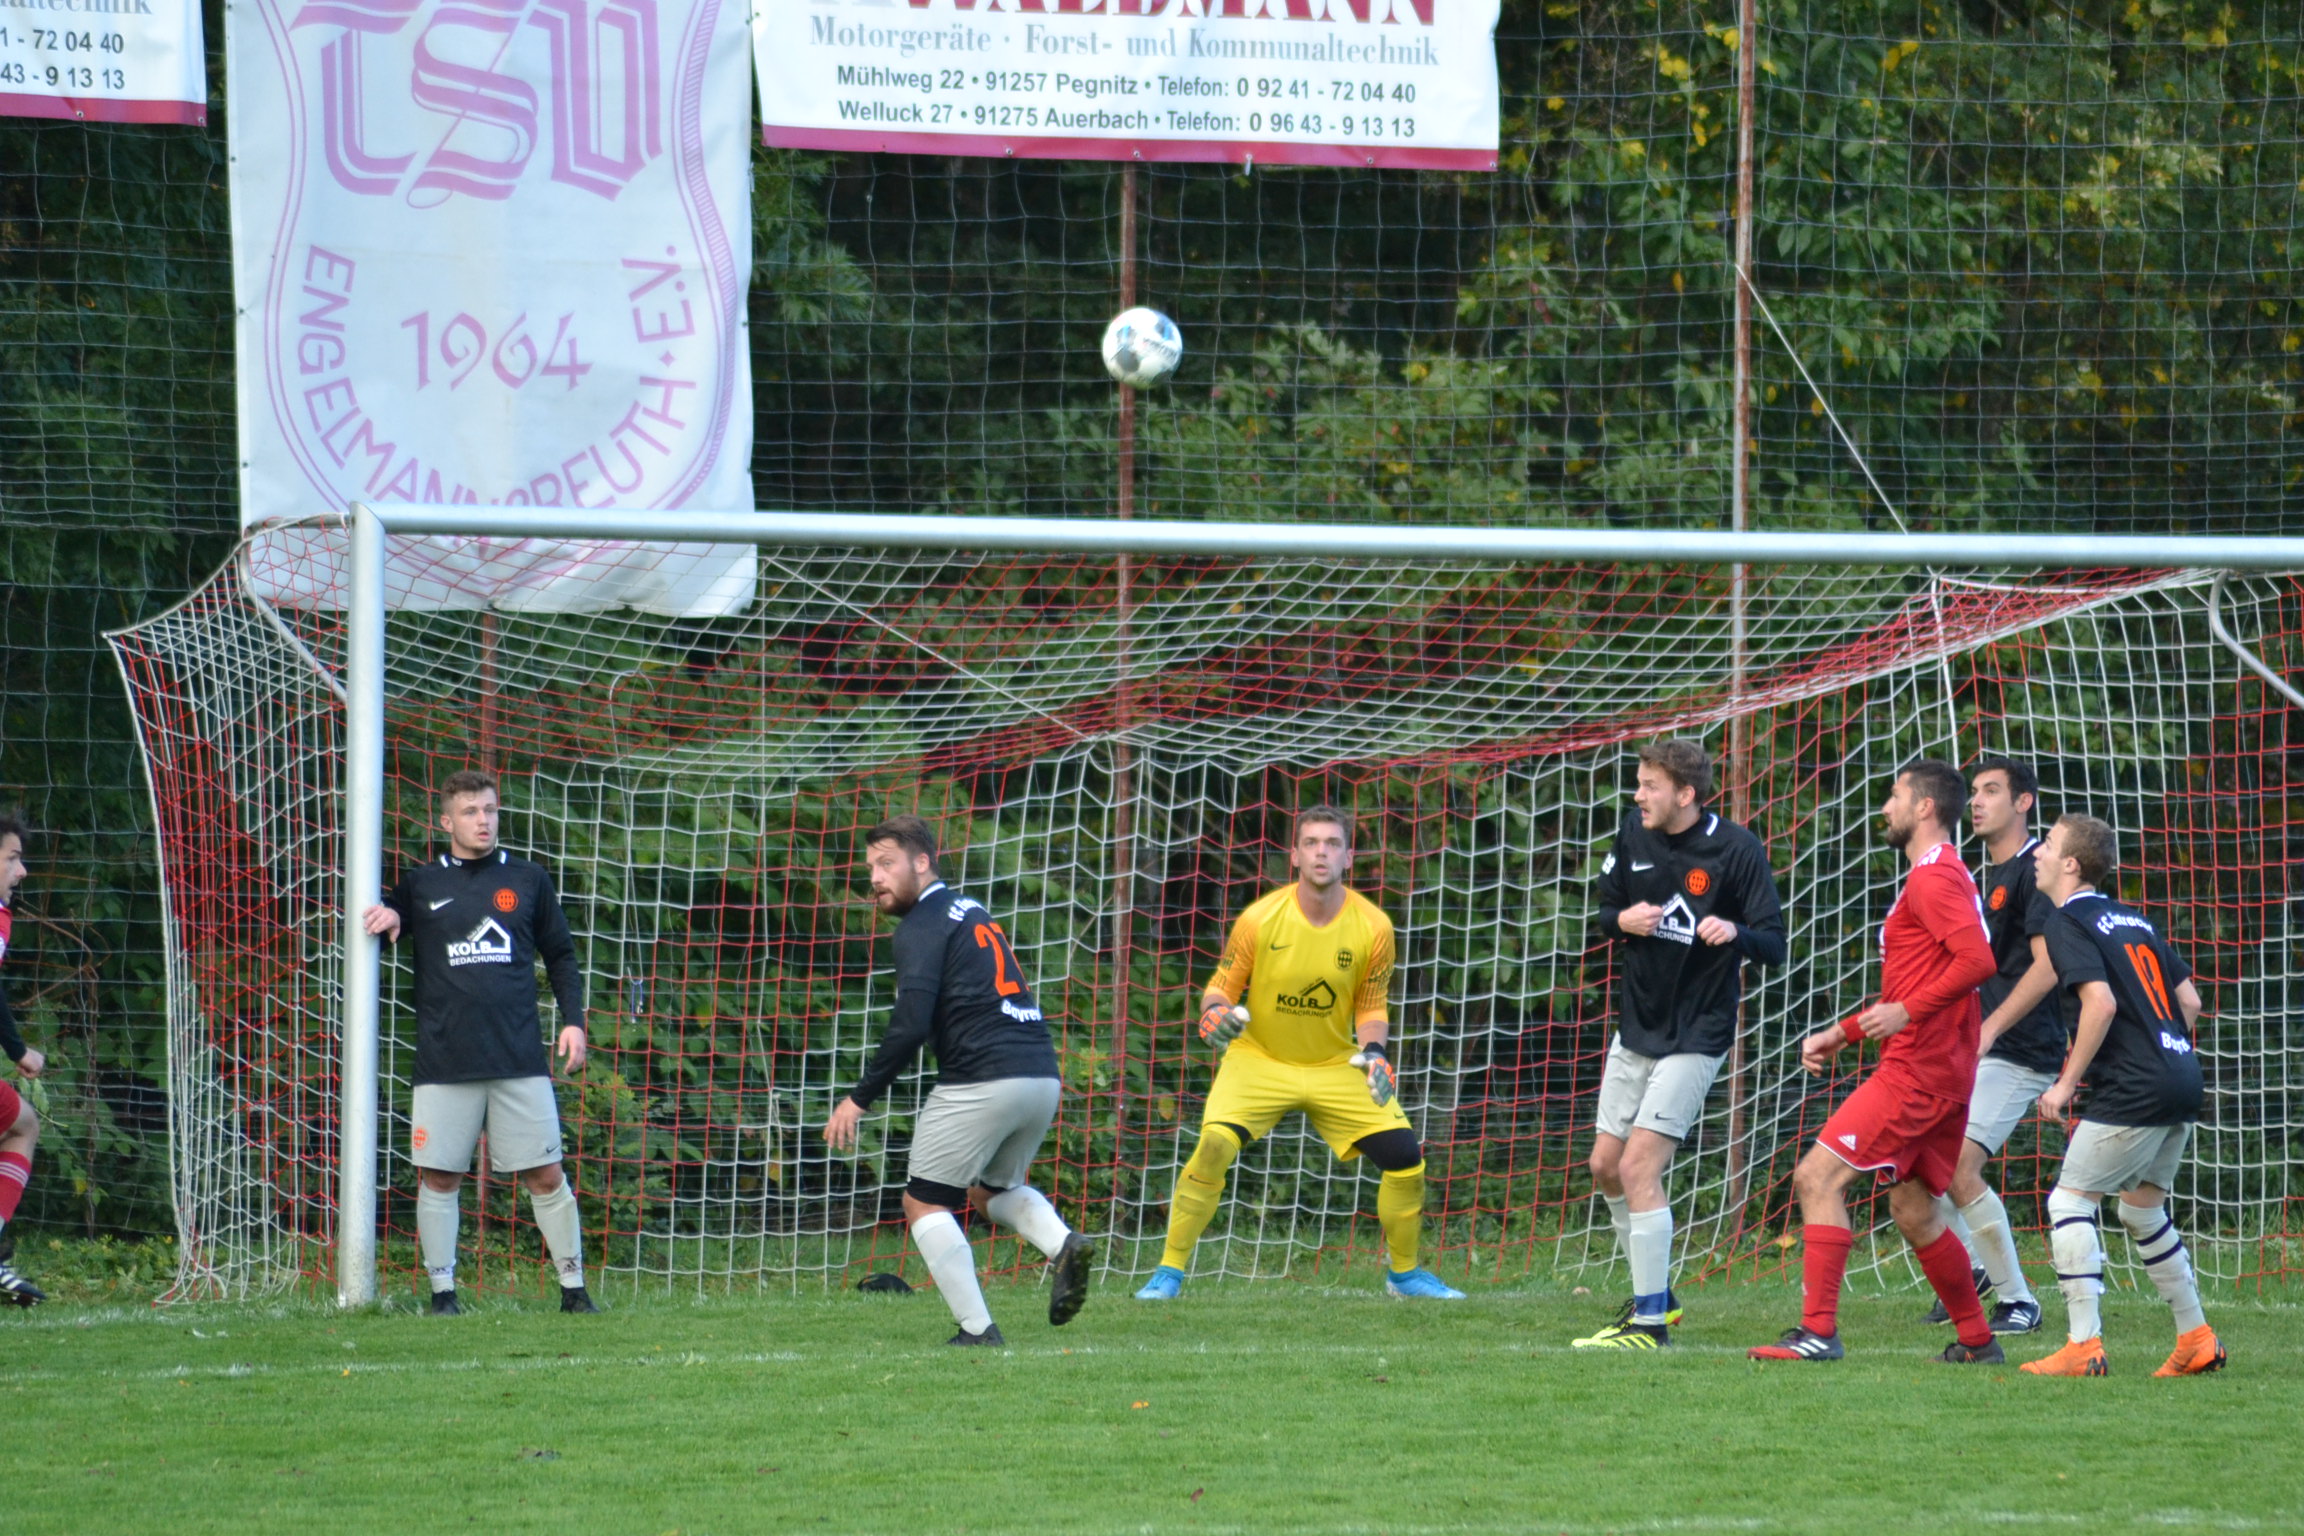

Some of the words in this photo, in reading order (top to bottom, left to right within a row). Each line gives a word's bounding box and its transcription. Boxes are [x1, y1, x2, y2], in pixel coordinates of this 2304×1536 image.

[32, 29, 58, 50] 72
[65, 31, 92, 52] 04
[100, 33, 124, 54] 40
[810, 15, 991, 58] Motorgeräte
[1025, 23, 1112, 55] Forst-
[1126, 28, 1177, 57] und
[1188, 28, 1440, 66] Kommunaltechnik
[1, 62, 26, 84] 43
[45, 66, 59, 86] 9
[68, 67, 93, 88] 13
[102, 69, 125, 90] 13
[838, 65, 932, 93] Mühlweg
[940, 69, 965, 90] 22
[985, 71, 1048, 93] 91257
[1056, 73, 1138, 99] Pegnitz
[1158, 76, 1229, 96] Telefon:
[1236, 77, 1249, 97] 0
[1257, 78, 1282, 98] 92
[1289, 80, 1309, 100] 41
[1331, 81, 1354, 101] 72
[1361, 82, 1384, 102] 04
[1391, 83, 1416, 103] 40
[838, 100, 924, 123] Welluck
[930, 104, 953, 124] 27
[974, 105, 1038, 127] 91275
[1045, 107, 1148, 129] Auerbach
[1167, 111, 1241, 131] Telefon:
[1249, 112, 1262, 132] 0
[1270, 113, 1294, 133] 96
[1300, 114, 1322, 134] 43
[1342, 116, 1354, 135] 9
[1362, 117, 1383, 137] 13
[1391, 118, 1415, 138] 13
[400, 310, 593, 392] 1964
[447, 941, 491, 957] KOLB
[449, 955, 511, 967] BEDACHUNGEN
[1277, 993, 1318, 1009] KOLB
